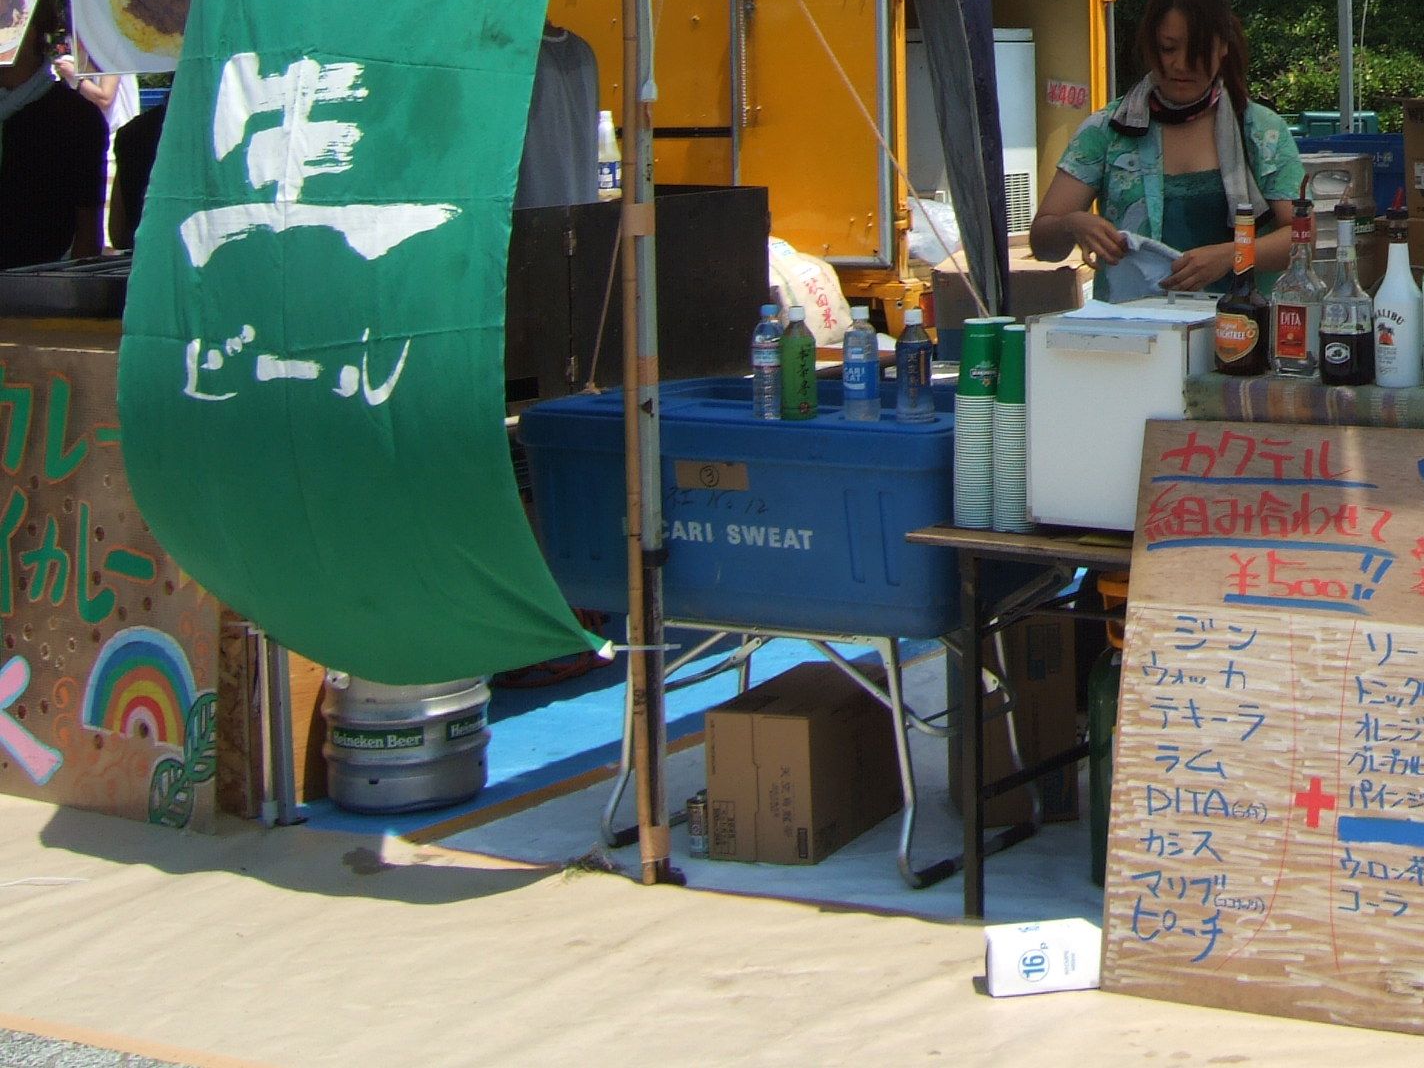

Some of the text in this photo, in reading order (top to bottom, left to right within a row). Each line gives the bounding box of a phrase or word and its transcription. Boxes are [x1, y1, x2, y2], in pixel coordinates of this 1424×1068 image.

[180, 51, 463, 267] 生
[1280, 312, 1301, 326] DITA
[183, 323, 412, 406] ビール
[1160, 431, 1352, 480] カクテル
[1143, 483, 1393, 543] 組み合わせて
[726, 523, 814, 550] SWEAT
[1174, 615, 1257, 651] ジン
[1151, 695, 1266, 742] テキーラ
[385, 734, 422, 748] Beer
[1155, 745, 1228, 780] ラム
[1147, 785, 1230, 819] DITA
[1130, 870, 1226, 906] マリブ
[1337, 889, 1409, 917] コーラ
[1132, 895, 1224, 963] ピーチ
